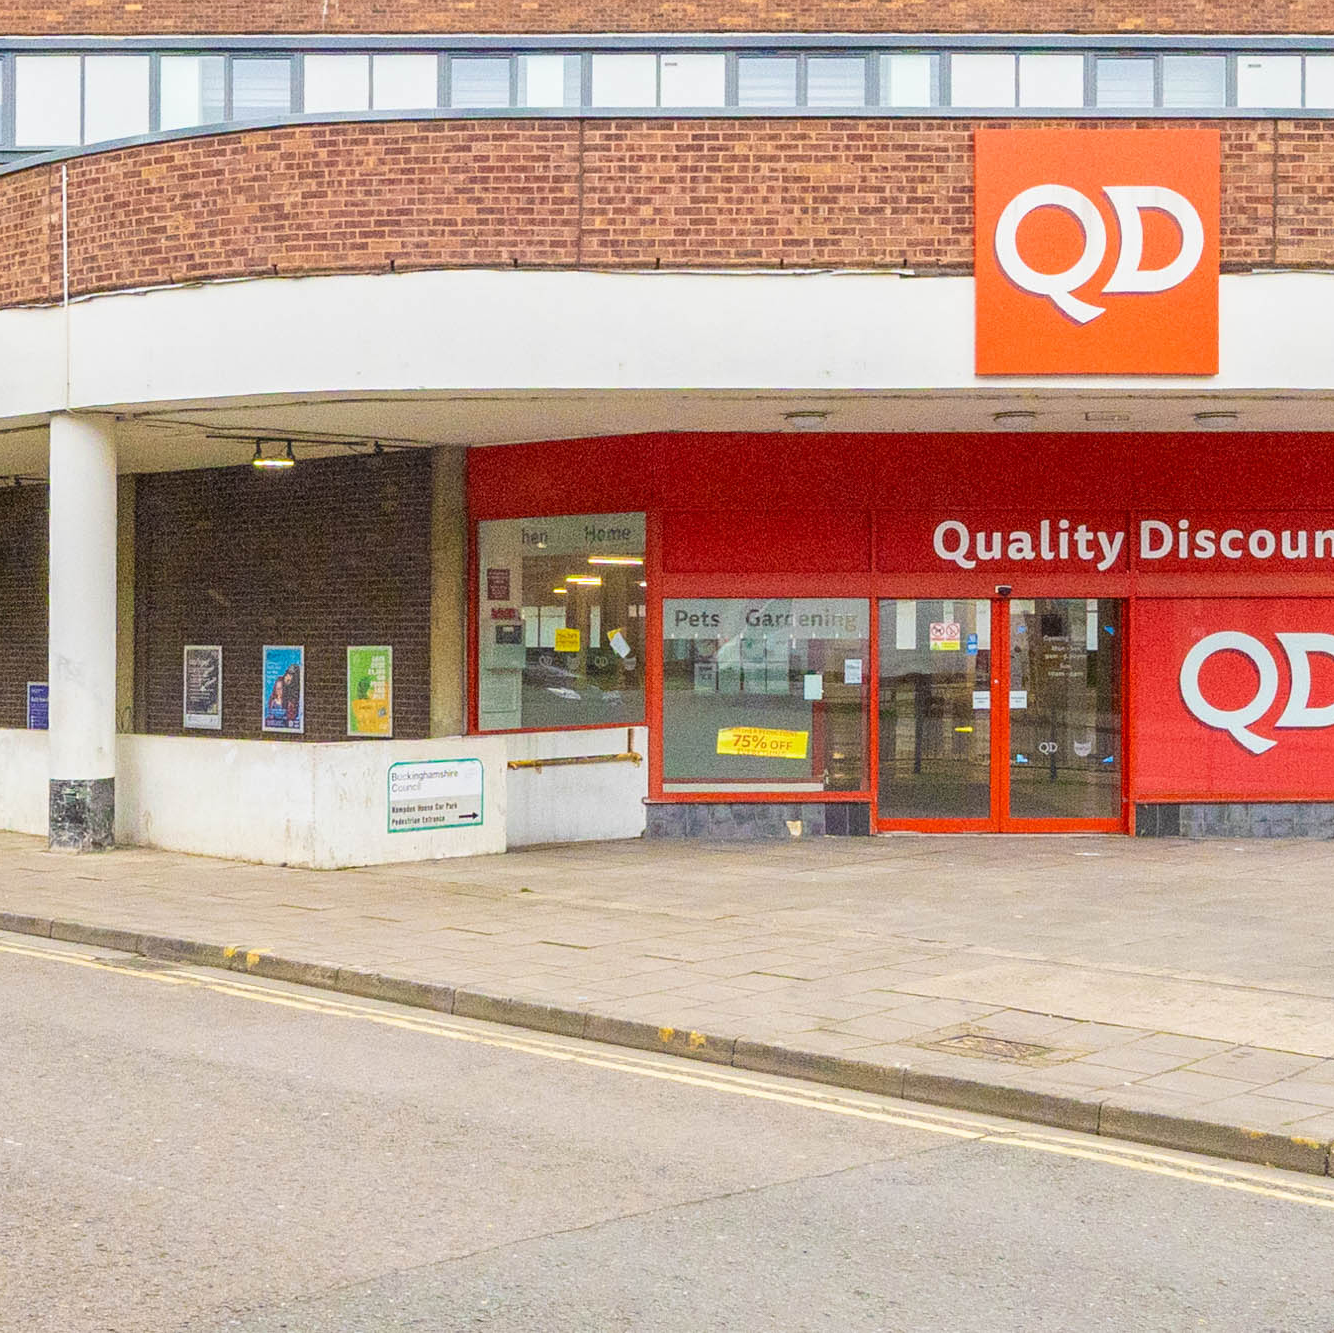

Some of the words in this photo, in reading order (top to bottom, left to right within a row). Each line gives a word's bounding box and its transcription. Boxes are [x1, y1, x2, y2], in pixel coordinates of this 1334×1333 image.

[995, 184, 1205, 325] QD
[675, 609, 721, 628] Pets
[732, 733, 767, 750] 75%
[770, 739, 794, 752] OFF
[1038, 742, 1058, 755] QD
[391, 770, 459, 782] Buckinghamshire
[391, 782, 422, 793] Council
[392, 817, 421, 826] Pedestrian
